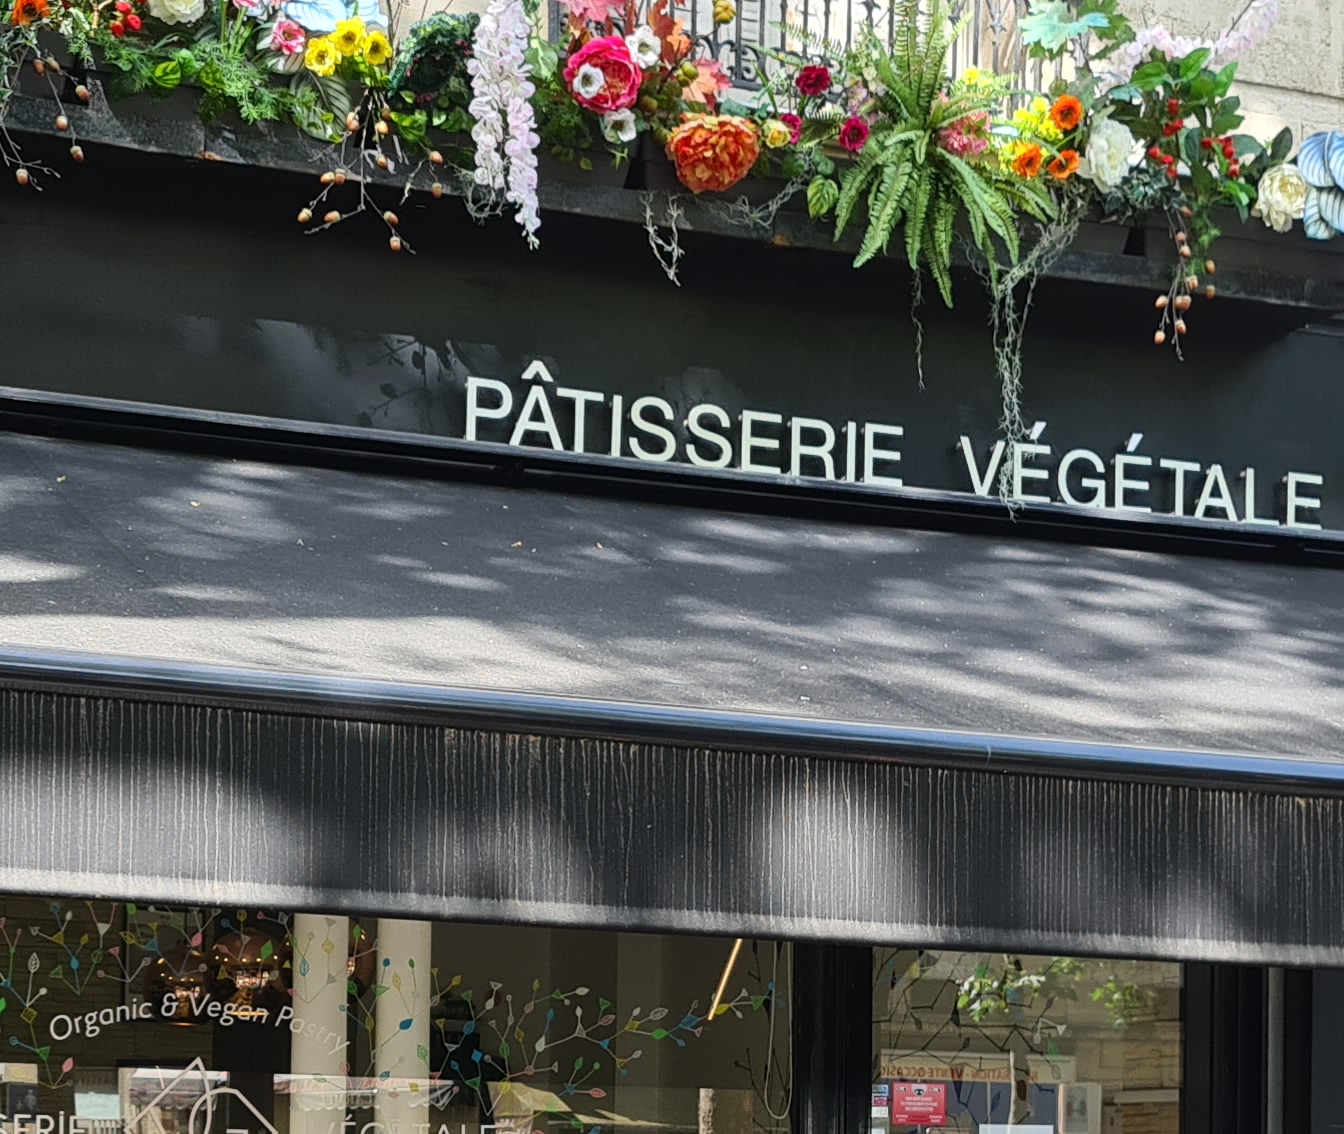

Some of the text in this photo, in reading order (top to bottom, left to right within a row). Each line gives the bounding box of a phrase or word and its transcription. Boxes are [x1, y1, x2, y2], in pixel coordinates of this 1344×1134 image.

[465, 360, 1324, 530] PÂTISSERIE VÉGÉTALE
[49, 992, 351, 1055] Organic & Vegan Pastry
